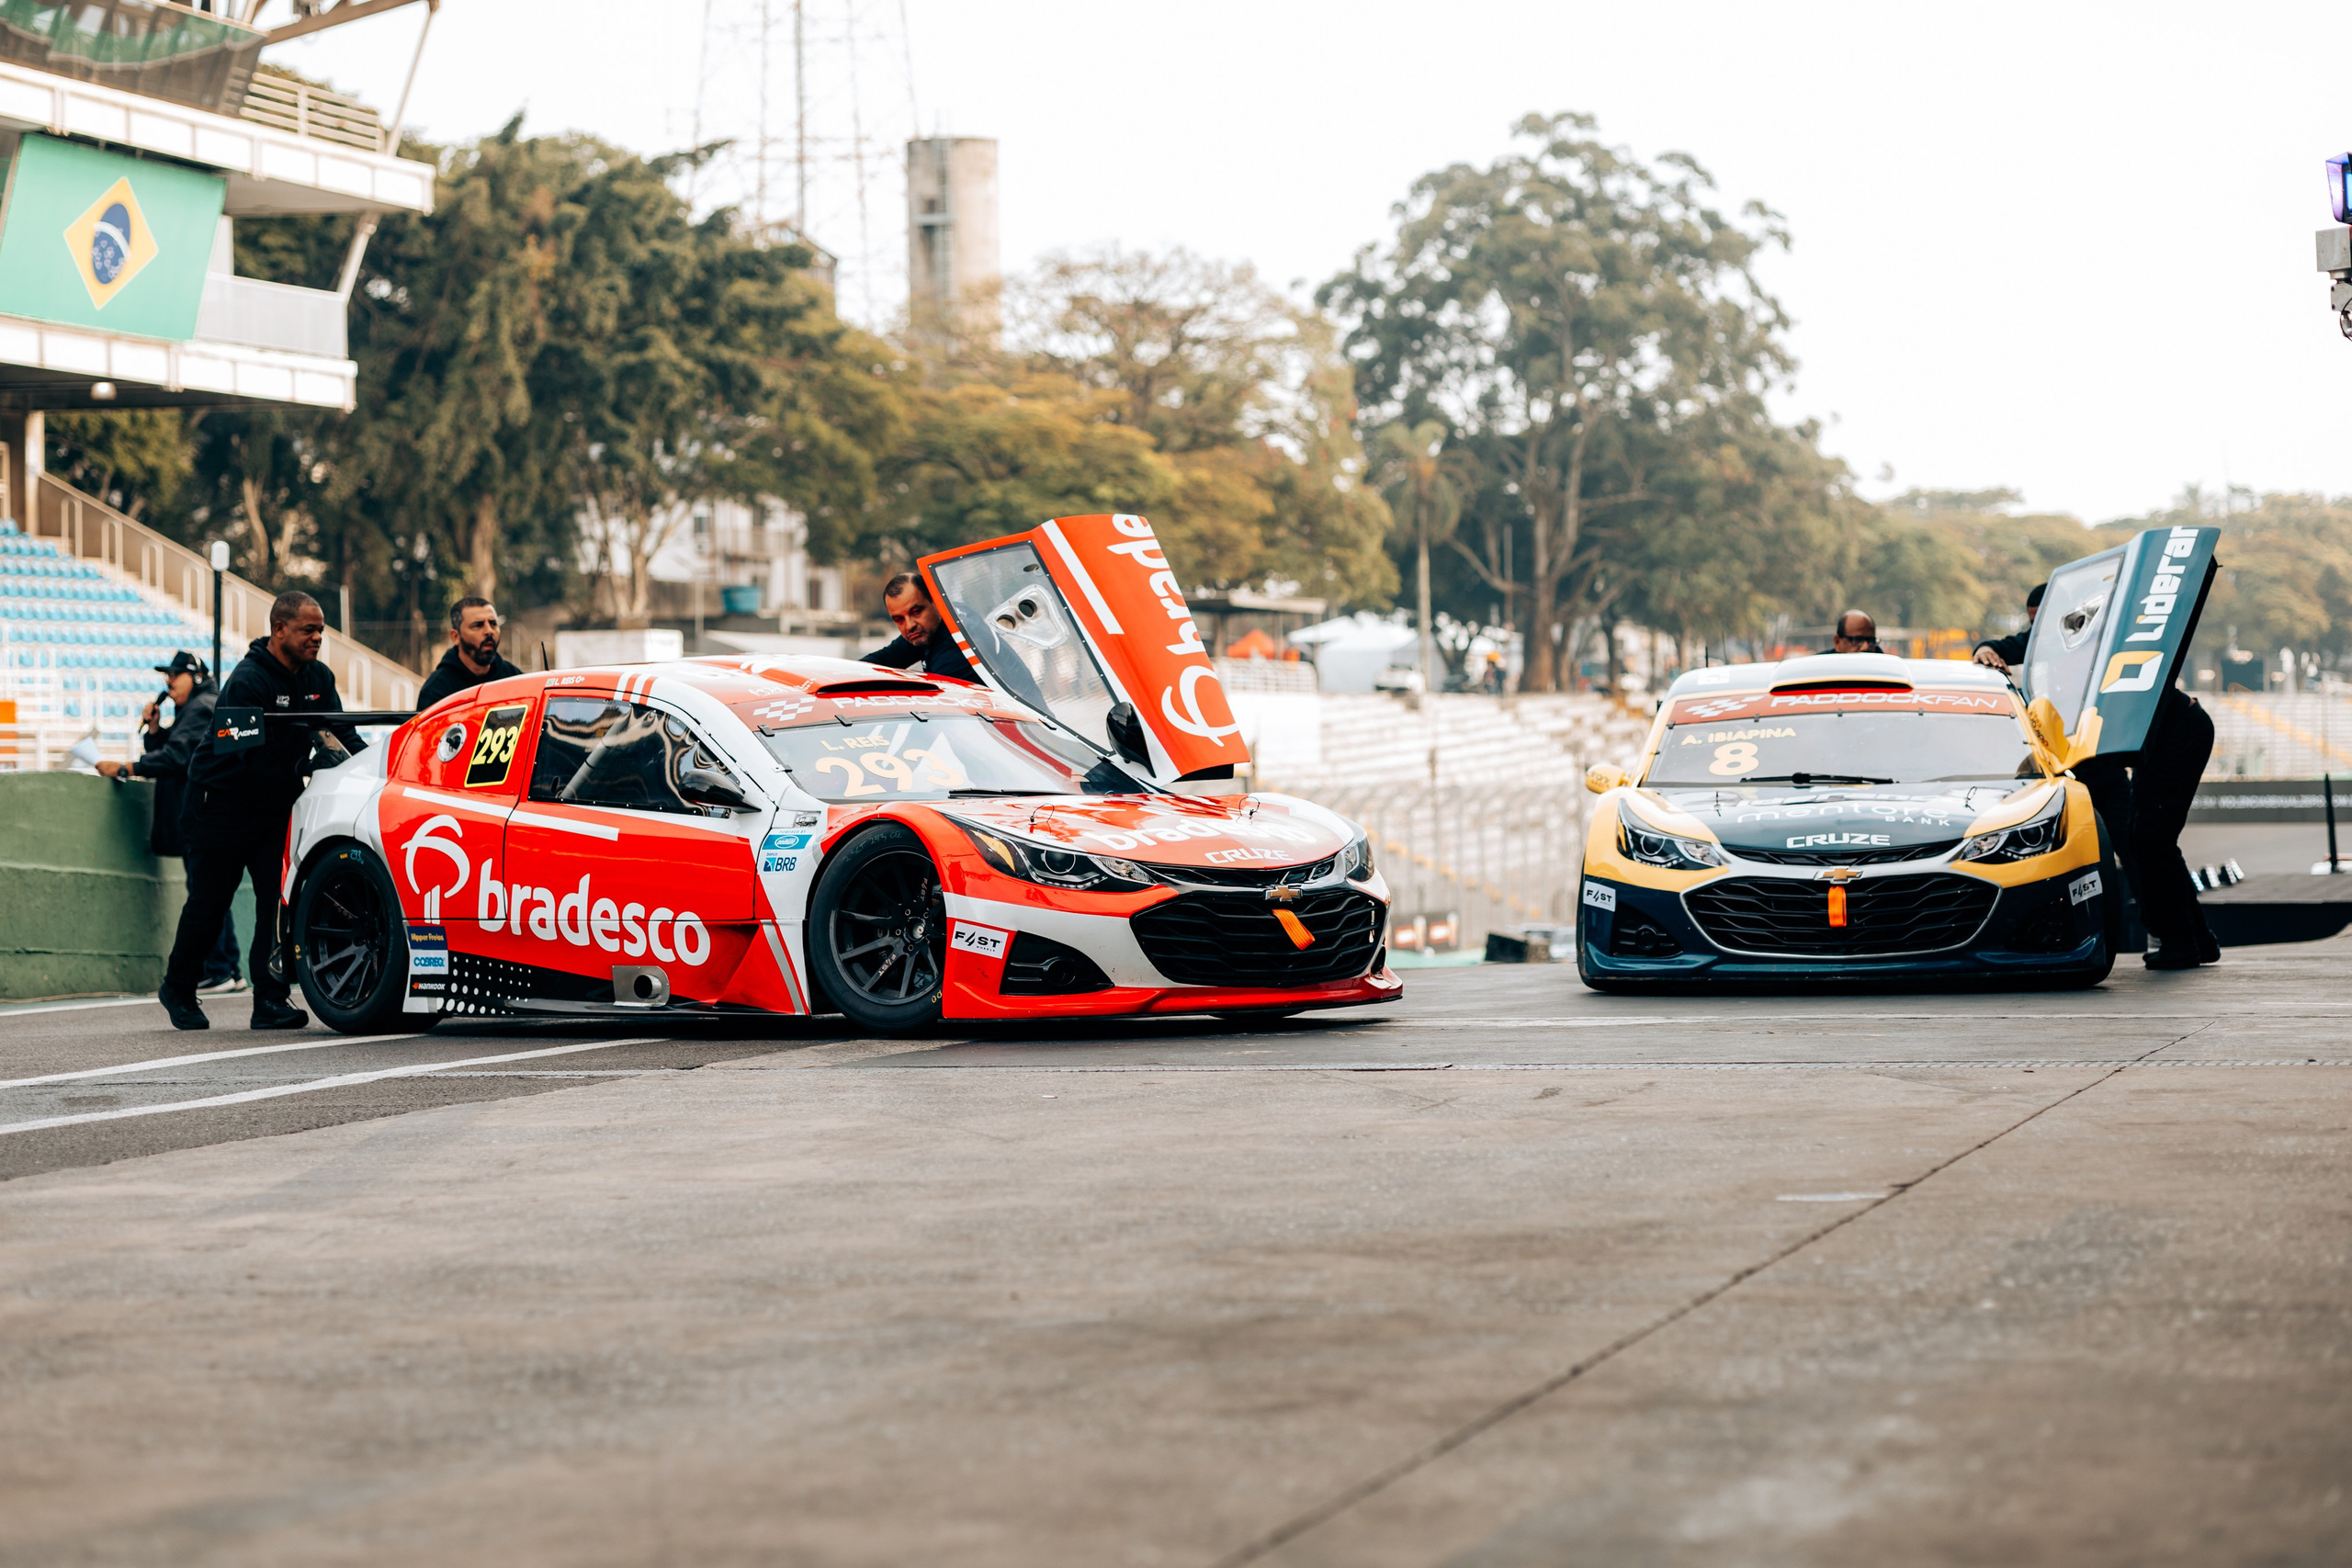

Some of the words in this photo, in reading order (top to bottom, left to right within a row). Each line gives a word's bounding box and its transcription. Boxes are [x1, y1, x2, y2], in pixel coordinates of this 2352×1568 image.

[560, 676, 575, 685] REIS
[1770, 693, 1998, 709] PADDOCKFAN
[471, 726, 520, 765] 293
[820, 739, 844, 751] L.
[842, 735, 890, 750] REIS
[1681, 734, 1702, 746] A.
[1708, 727, 1797, 743] IBIAPINA
[1709, 741, 1759, 776] 8
[815, 748, 965, 798] 293
[1736, 802, 1951, 824] mentore
[1884, 816, 1951, 826] BANK
[1787, 831, 1891, 849] CRUZE
[775, 856, 797, 872] BRB
[1204, 848, 1295, 864] CRUZE
[478, 857, 711, 966] bradesco
